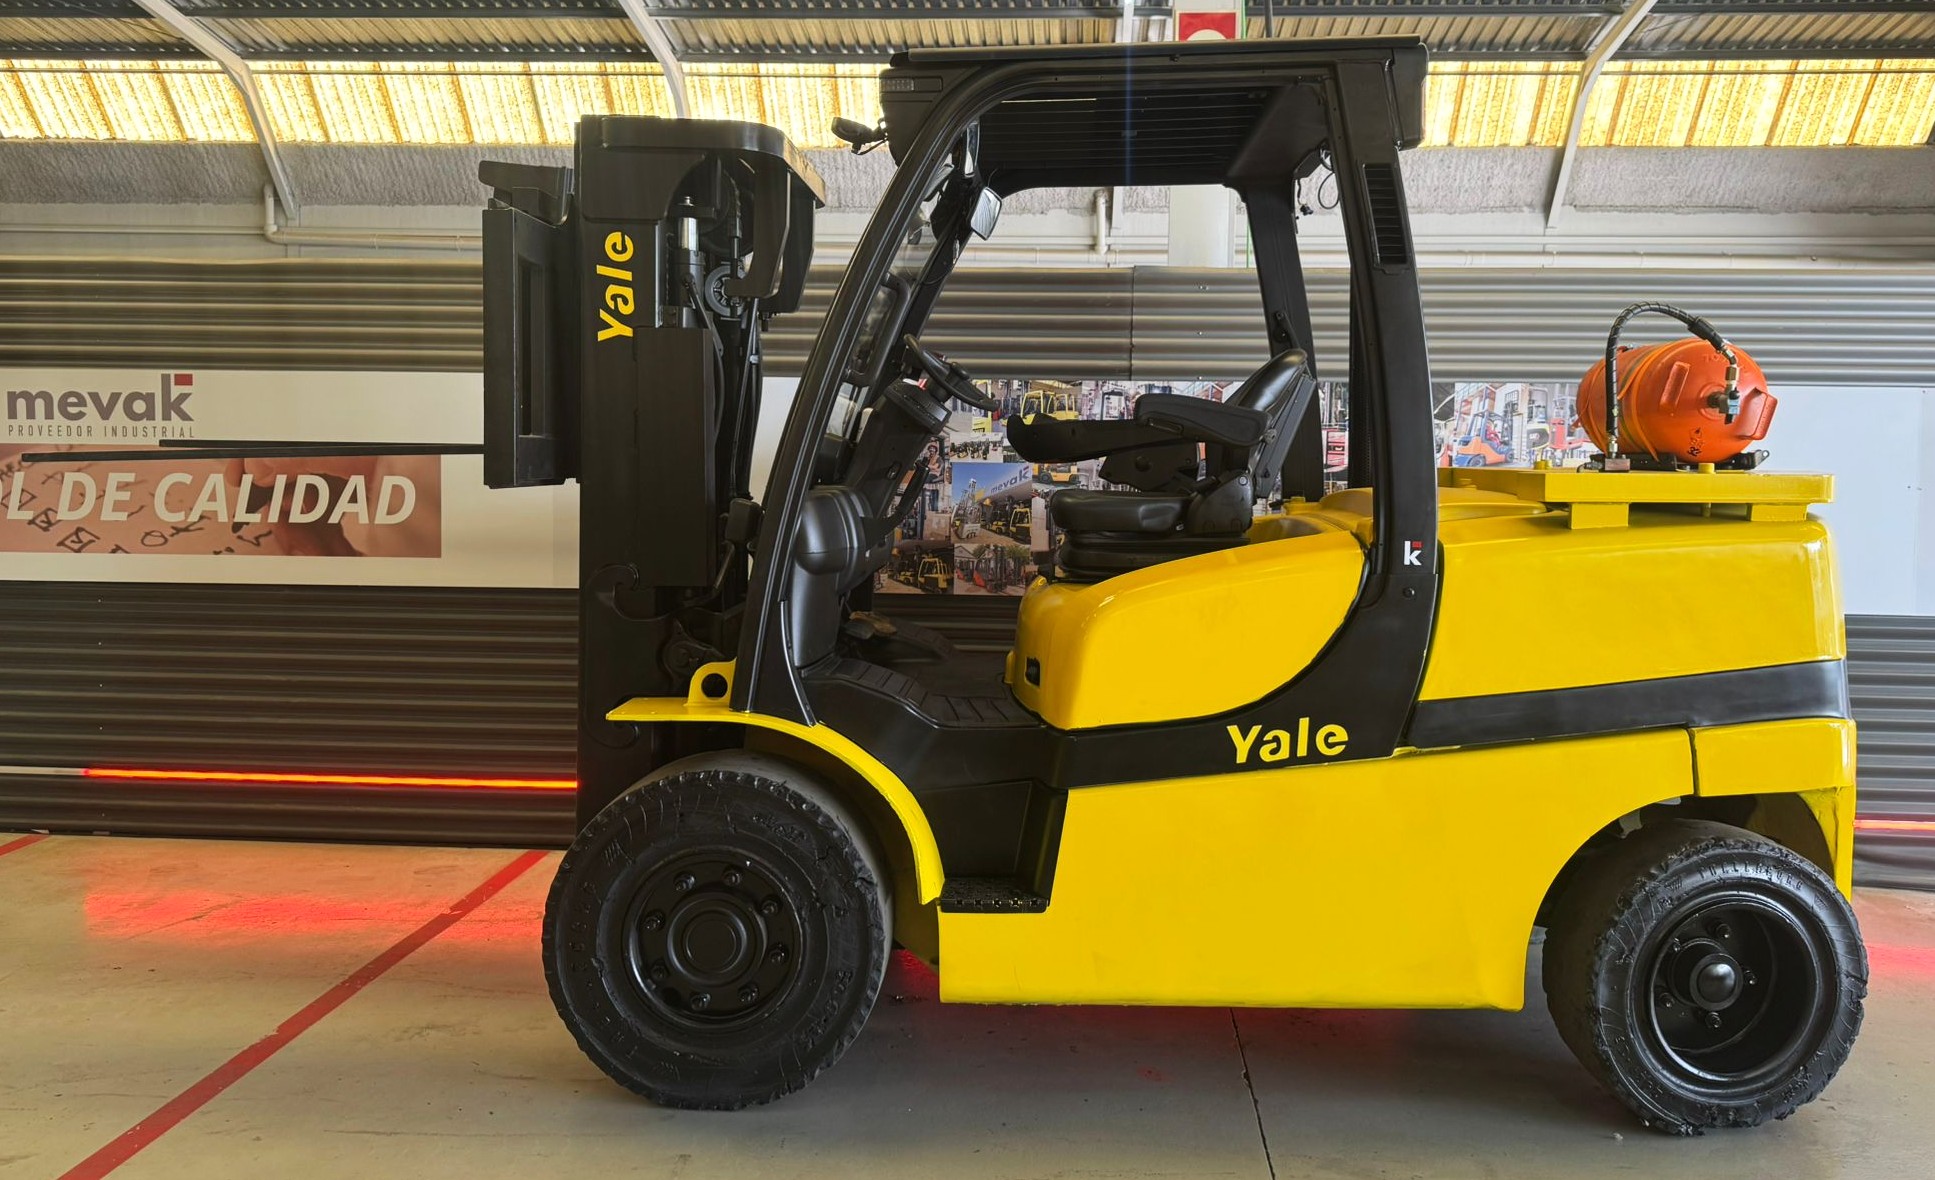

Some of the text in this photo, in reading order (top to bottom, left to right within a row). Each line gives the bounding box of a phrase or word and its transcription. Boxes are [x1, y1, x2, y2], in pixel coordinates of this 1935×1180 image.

[596, 231, 634, 342] Yale
[7, 373, 195, 422] mevak
[8, 424, 195, 438] PROVEEDOR INDUSTRIAL
[0, 471, 417, 525] L DE CALIDAD
[990, 466, 1030, 494] mevak
[1226, 716, 1349, 764] Yale
